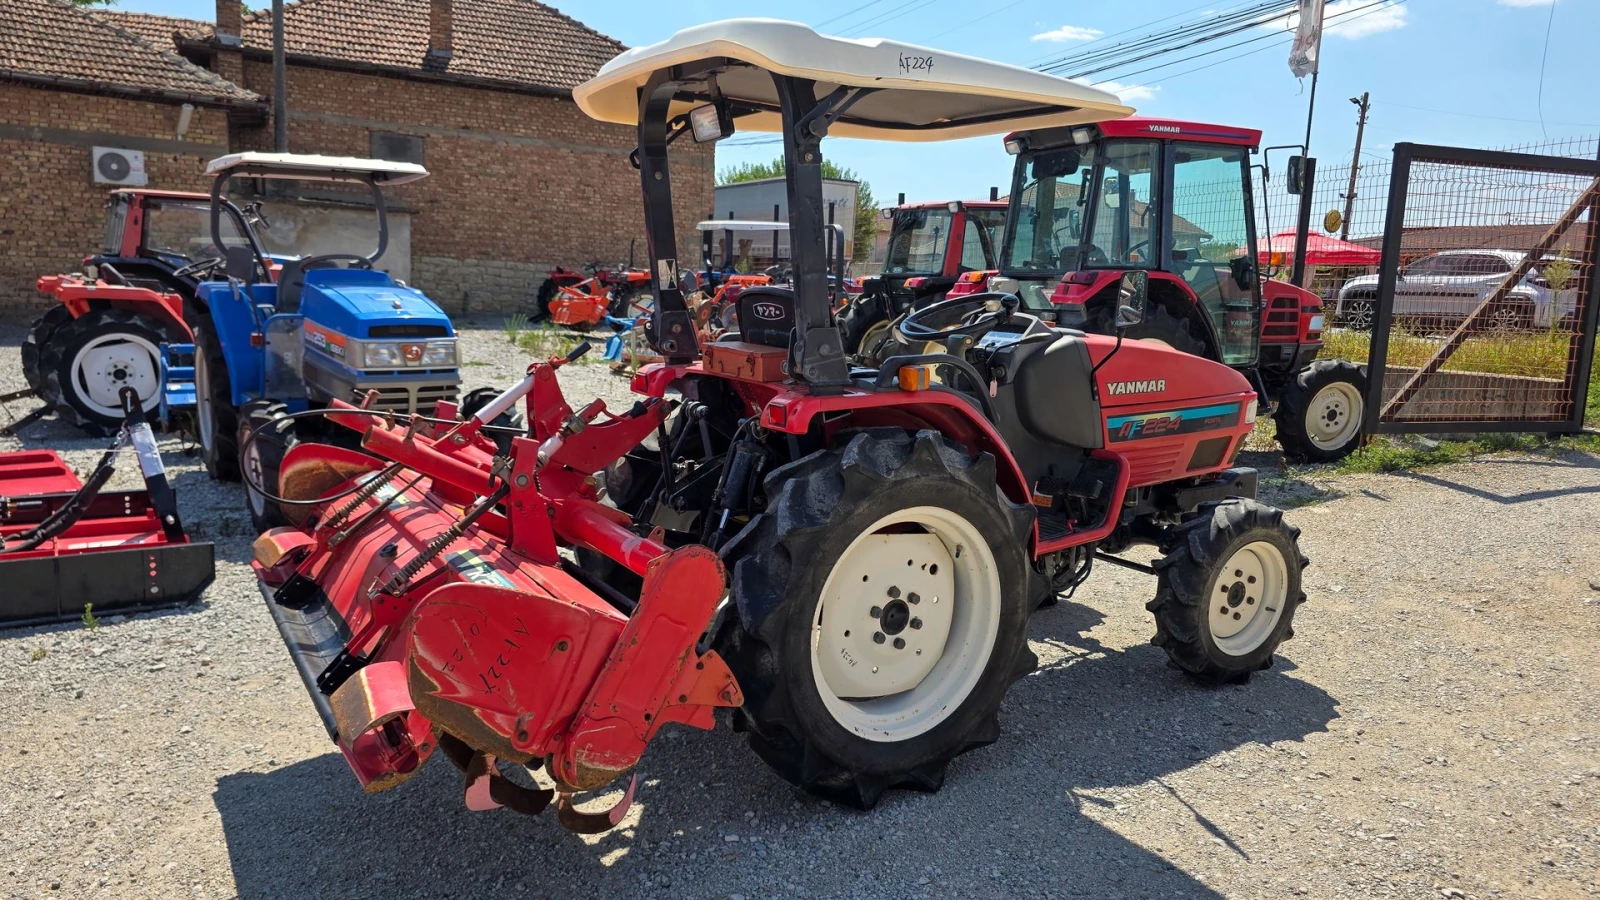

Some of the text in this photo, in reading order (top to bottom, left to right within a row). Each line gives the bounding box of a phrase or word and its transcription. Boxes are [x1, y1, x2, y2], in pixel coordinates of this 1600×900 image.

[899, 52, 934, 75] AF224
[1149, 125, 1180, 133] YANMAR
[1107, 379, 1166, 395] YANMAR
[1118, 415, 1182, 439] AF224
